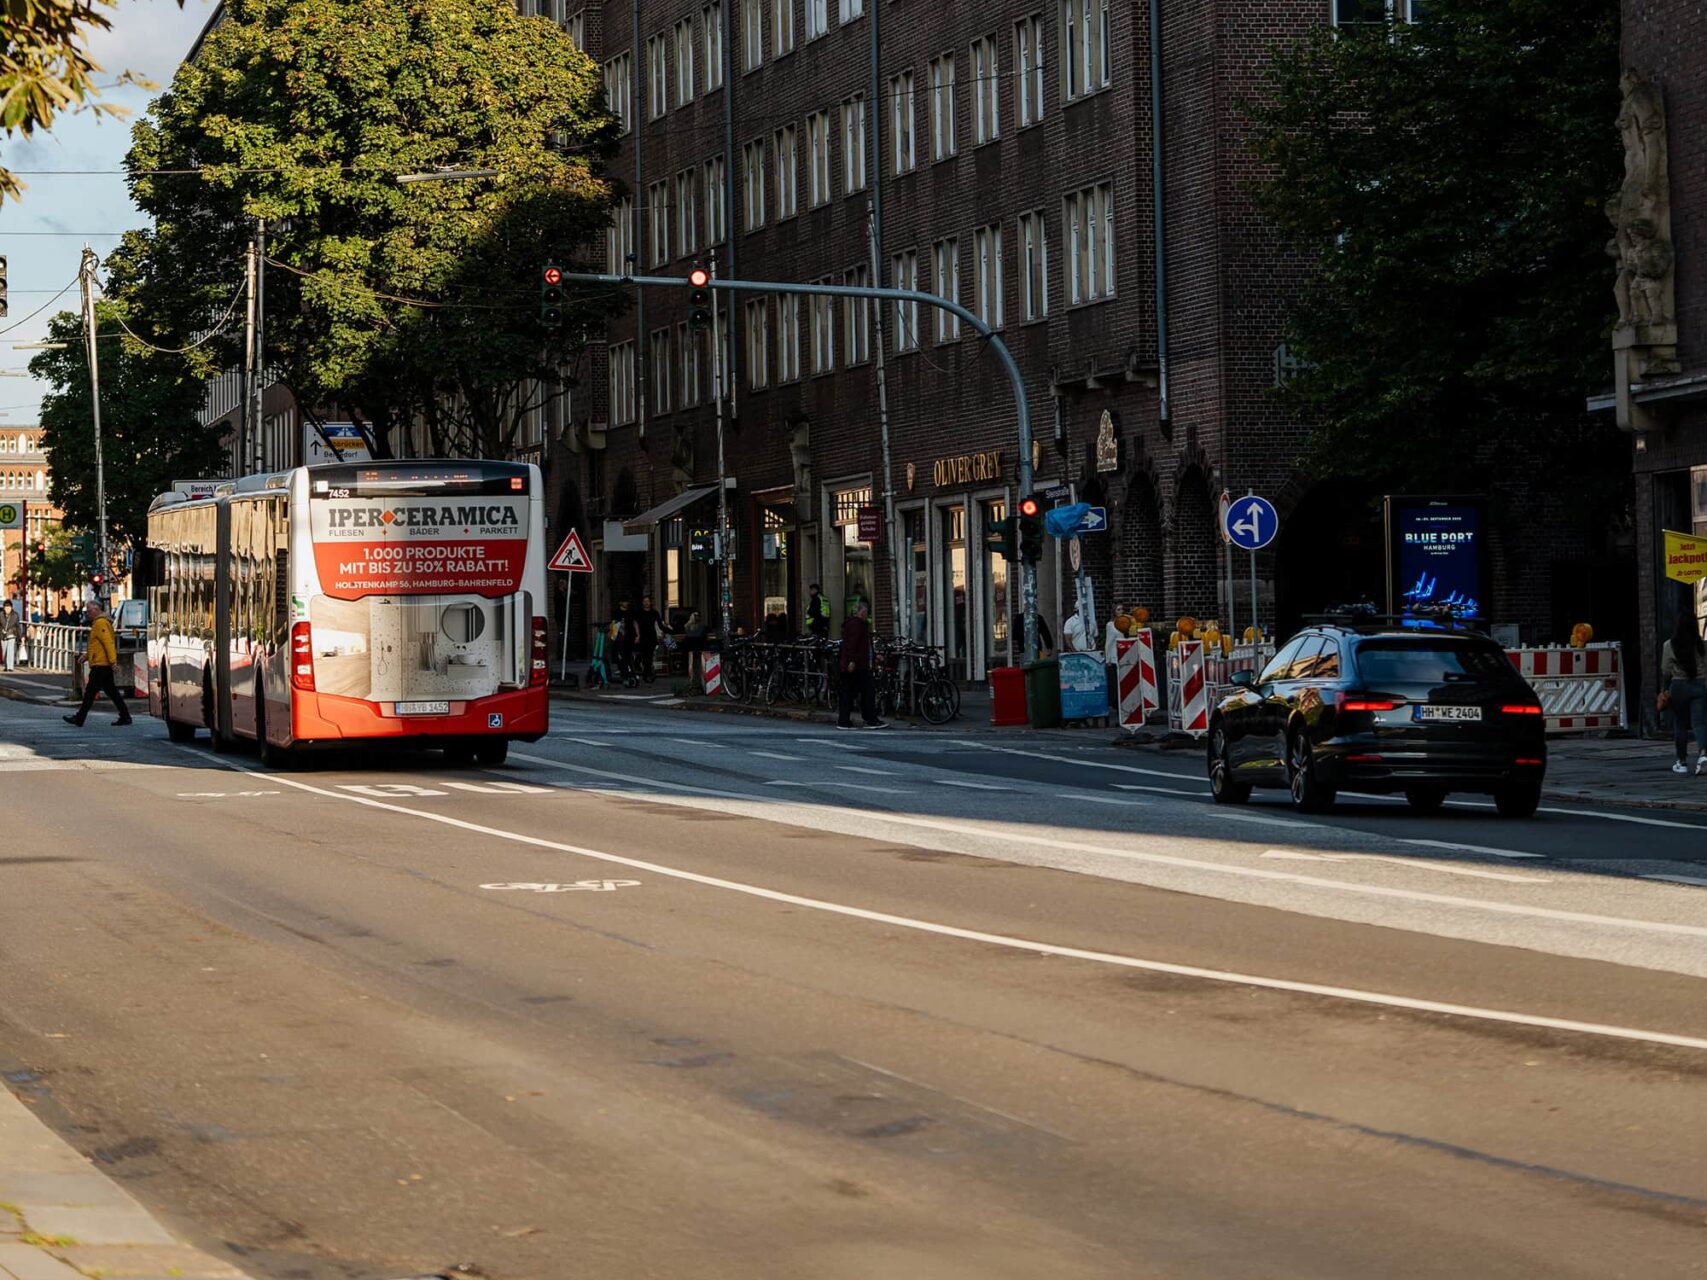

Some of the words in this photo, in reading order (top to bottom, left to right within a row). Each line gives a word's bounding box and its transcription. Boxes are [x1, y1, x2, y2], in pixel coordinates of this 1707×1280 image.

[933, 456, 972, 487] OLIVER
[972, 451, 1001, 481] GREY
[191, 484, 213, 492] Bereich
[328, 489, 349, 499] 7452
[329, 508, 384, 528] IPER
[393, 506, 518, 527] CERAMICA
[329, 529, 364, 537] FLIESEN
[409, 526, 440, 536] BÄDER
[480, 526, 518, 535] PARKETT
[1405, 532, 1438, 543] BLUE
[1440, 532, 1474, 543] PORT
[363, 548, 403, 560] 1.000
[406, 546, 485, 559] PRODUKTE
[339, 562, 367, 574] MIT
[369, 562, 391, 574] BIS
[393, 562, 414, 573] ZU
[415, 560, 443, 573] 50%
[446, 559, 509, 572] RABATT!
[335, 581, 398, 590] HOLSTENKAMP
[399, 580, 412, 589] 56,
[412, 578, 513, 588] HAMBURG-BAHRENFELD
[1421, 707, 1435, 718] HH
[1441, 707, 1454, 718] WE
[1456, 708, 1480, 719] 2404
